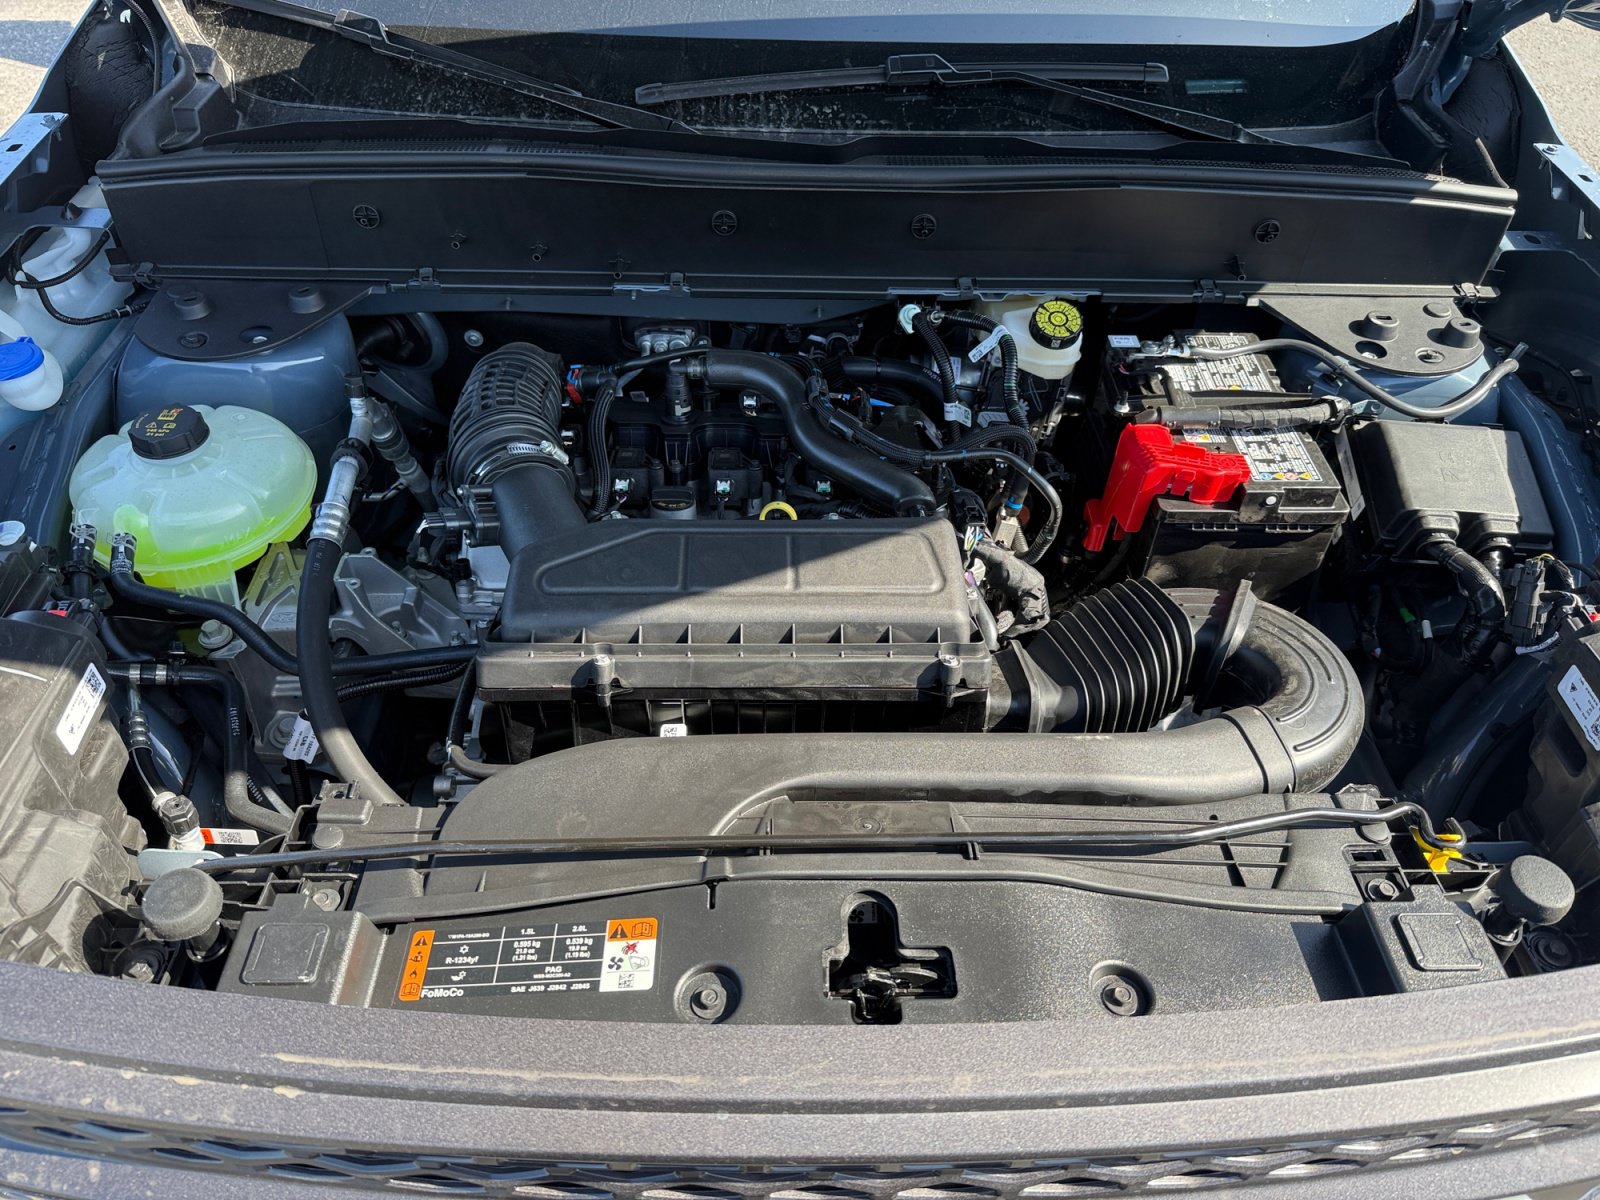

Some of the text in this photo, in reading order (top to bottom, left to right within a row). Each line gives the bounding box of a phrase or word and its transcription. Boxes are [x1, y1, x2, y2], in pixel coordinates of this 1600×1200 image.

[572, 925, 588, 933] 2.0L
[513, 940, 541, 949] 0.595 kg
[565, 937, 594, 946] 0.539 kg
[445, 956, 479, 965] R-1234yf
[544, 965, 562, 973] PAG
[420, 987, 464, 999] FoMoCo
[510, 985, 526, 993] SAE
